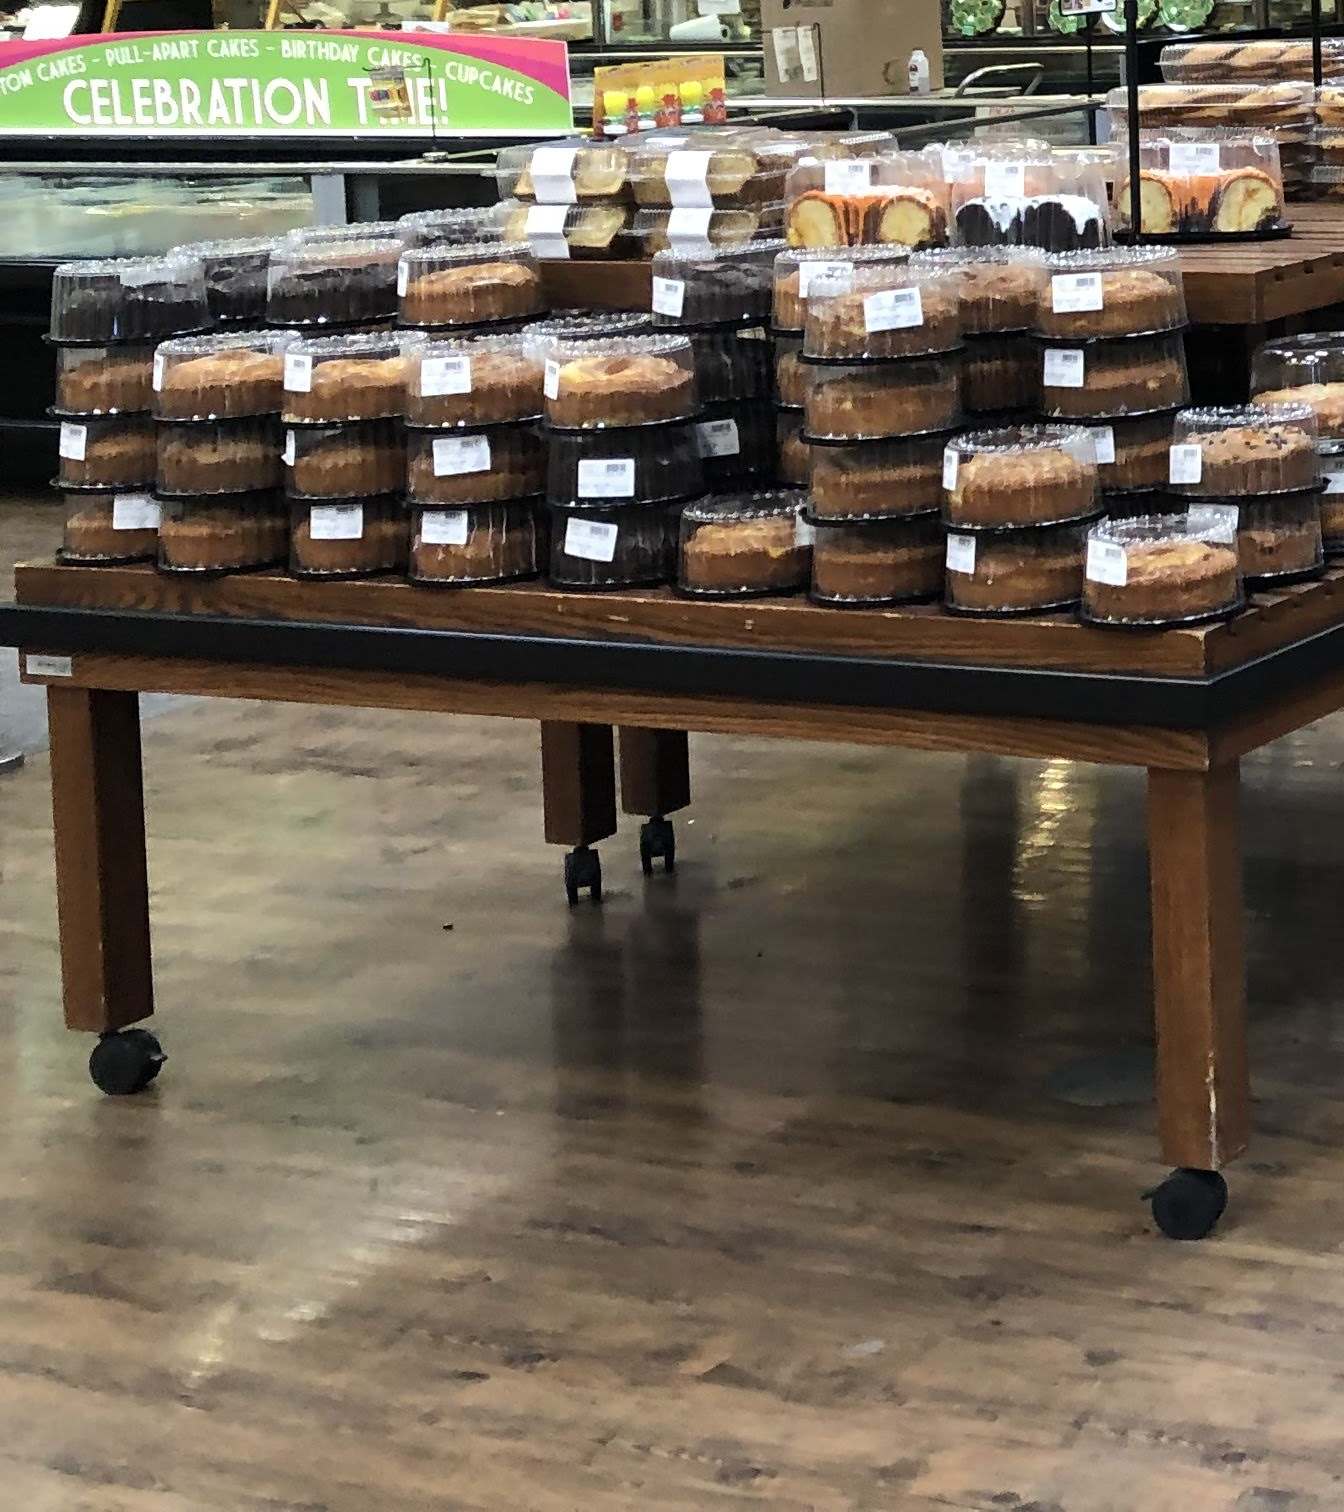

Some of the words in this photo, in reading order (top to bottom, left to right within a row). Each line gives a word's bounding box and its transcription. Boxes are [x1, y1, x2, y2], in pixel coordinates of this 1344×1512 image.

[36, 54, 87, 83] CAKES
[105, 39, 200, 68] PULL-APART
[206, 38, 260, 59] CAKES
[281, 39, 360, 64] BIRTHDAY
[367, 46, 424, 73] CAKES
[444, 60, 535, 106] CUPCAKES
[62, 76, 331, 126] CELEBRATION
[347, 76, 449, 126] TE!
